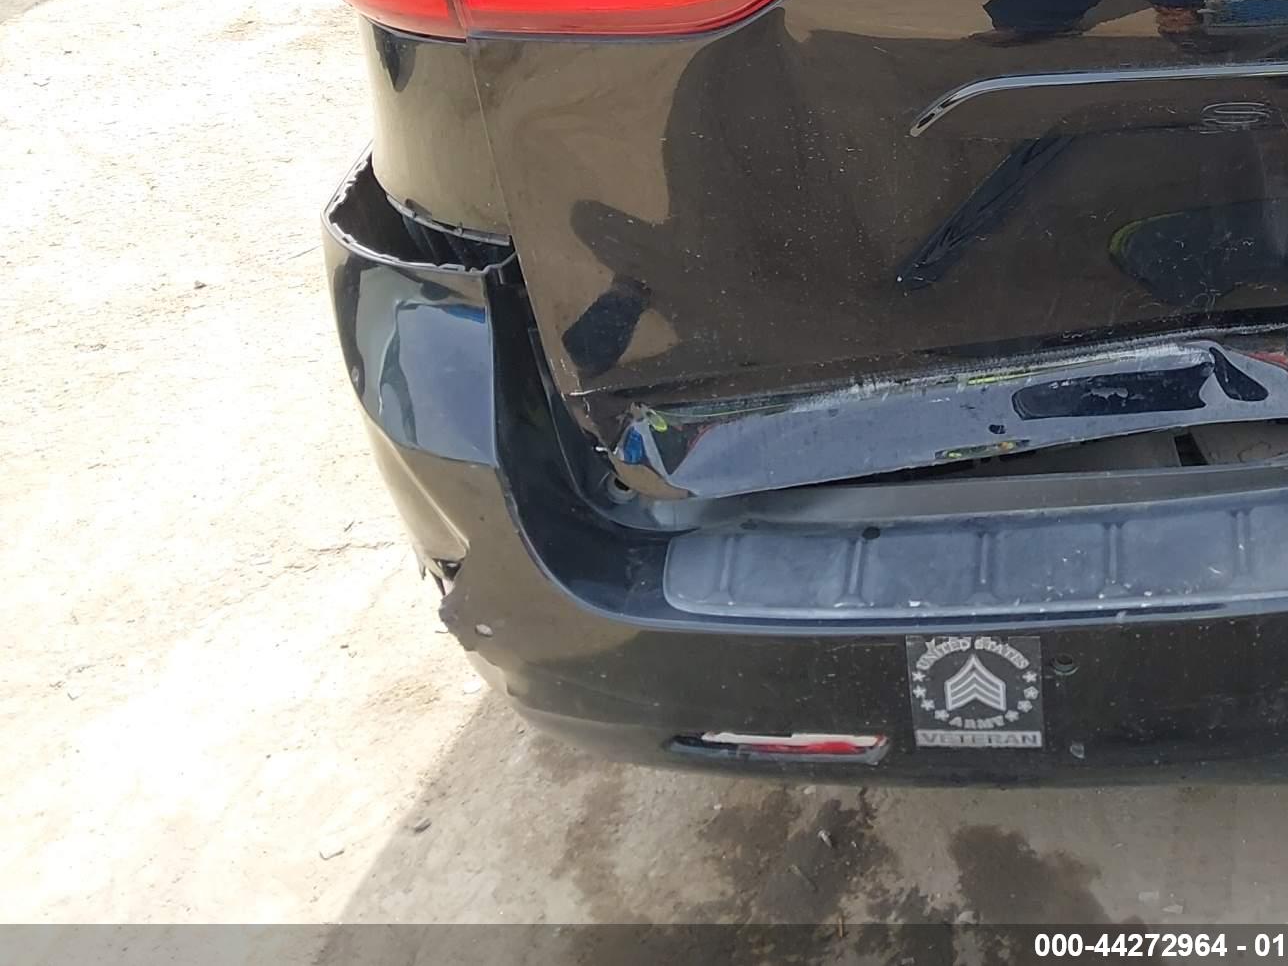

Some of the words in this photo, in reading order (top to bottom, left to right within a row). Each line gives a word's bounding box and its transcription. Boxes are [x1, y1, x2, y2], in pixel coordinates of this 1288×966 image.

[915, 636, 972, 670] UNITED
[974, 636, 1030, 670] STATES
[948, 715, 1005, 729] ARMY
[917, 732, 1040, 745] VETERAN
